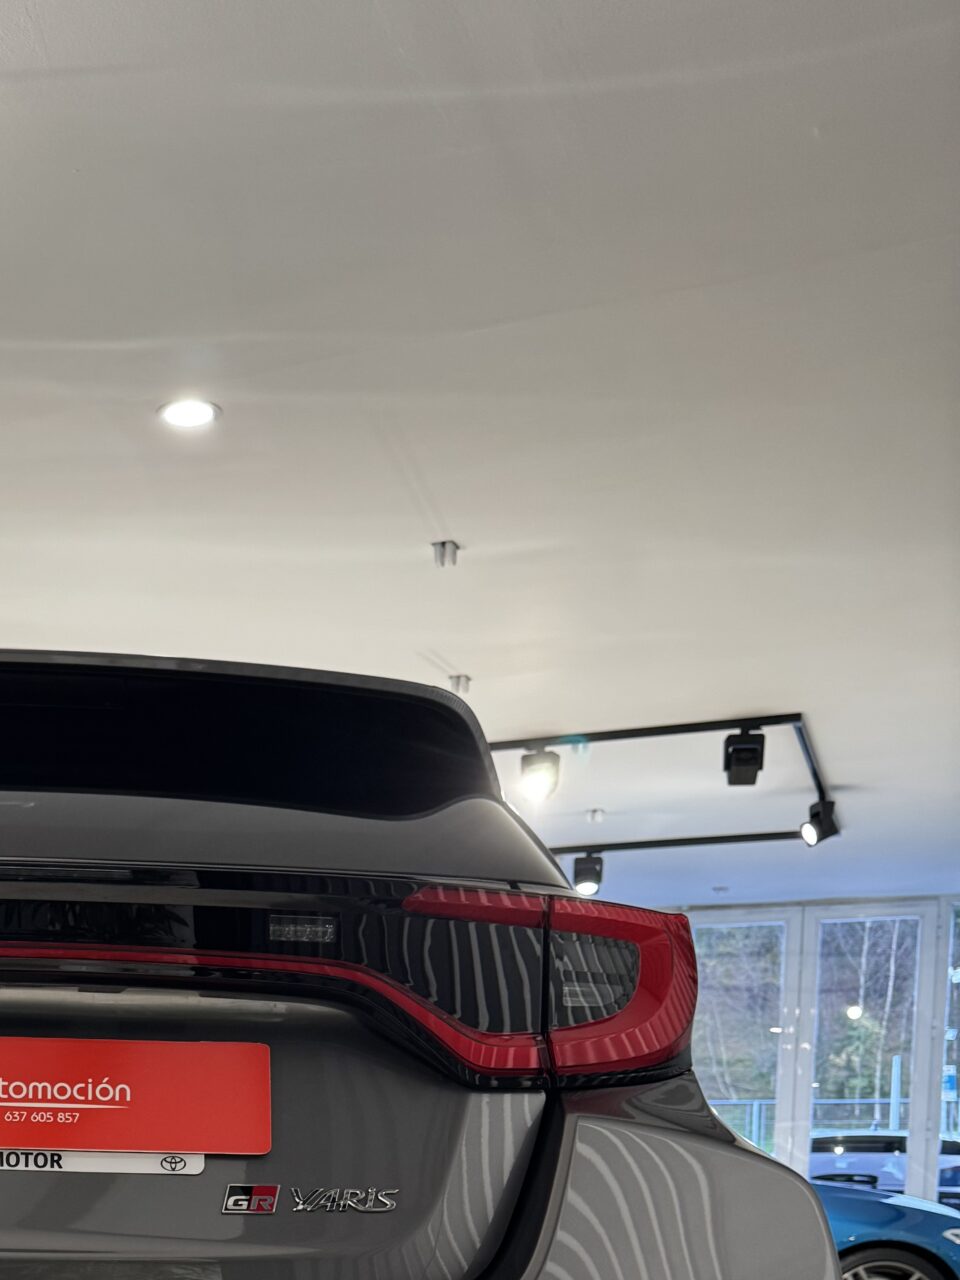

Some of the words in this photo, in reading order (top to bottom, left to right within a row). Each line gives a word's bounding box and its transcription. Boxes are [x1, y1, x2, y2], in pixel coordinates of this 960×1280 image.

[4, 1111, 27, 1122] 637
[30, 1112, 54, 1122] 605
[57, 1112, 80, 1123] 857
[226, 1195, 274, 1210] GR
